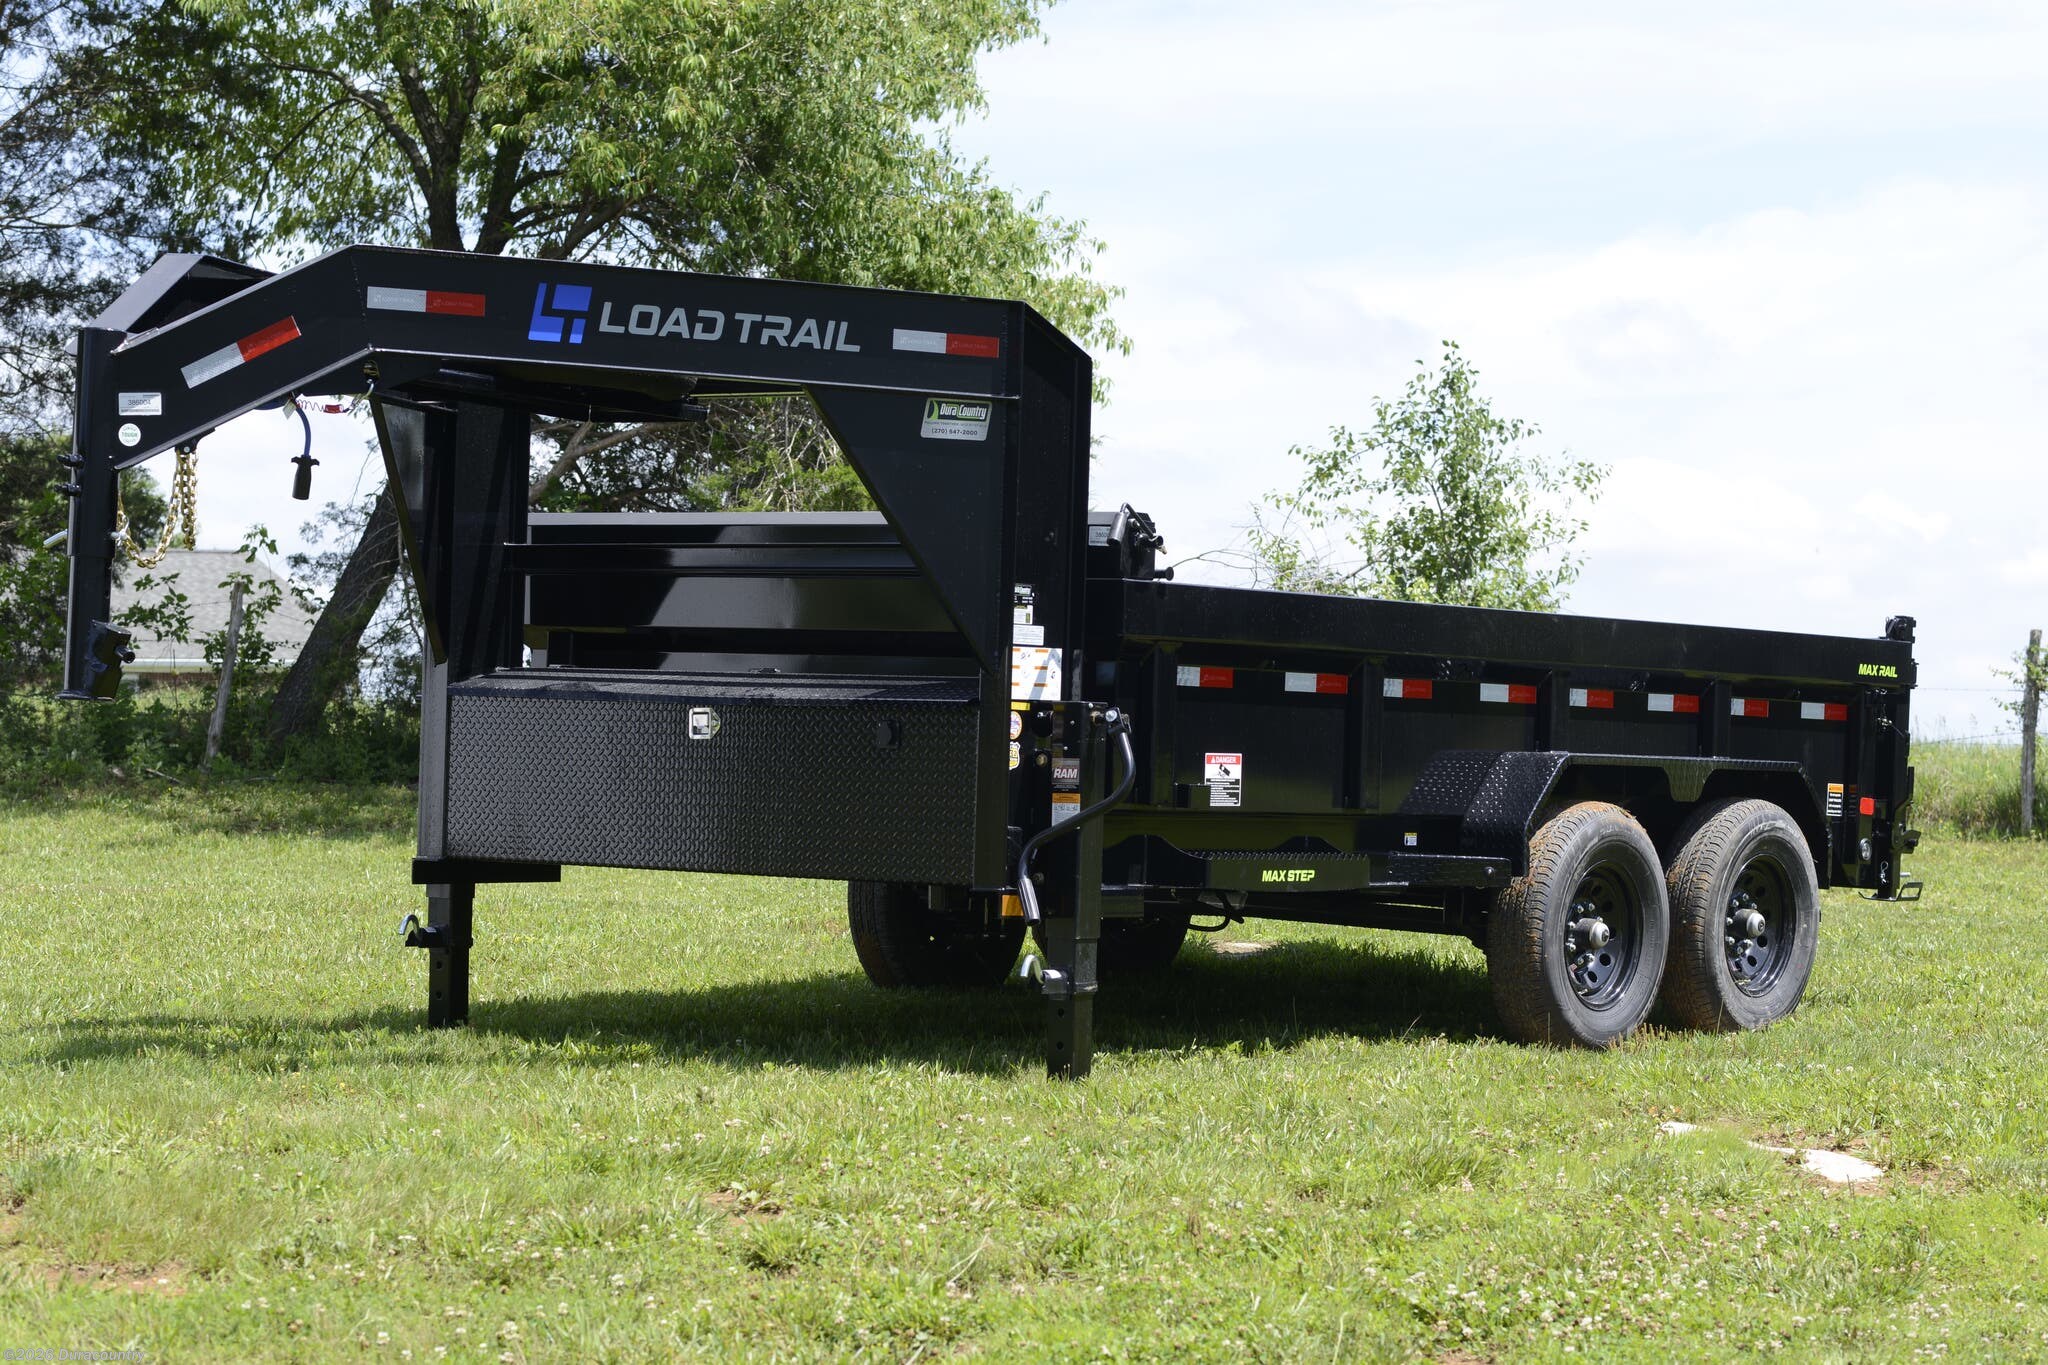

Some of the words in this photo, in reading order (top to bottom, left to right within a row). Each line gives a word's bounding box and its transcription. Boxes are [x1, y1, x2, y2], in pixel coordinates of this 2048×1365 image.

[599, 301, 725, 342] LOAD
[734, 312, 861, 353] TRAIL
[940, 403, 957, 415] Dura
[959, 404, 987, 420] Country
[1858, 664, 1878, 676] MAX
[1878, 665, 1898, 678] RAIL
[1053, 768, 1078, 779] RAM
[1261, 870, 1286, 882] MAX
[1287, 870, 1315, 882] STEP
